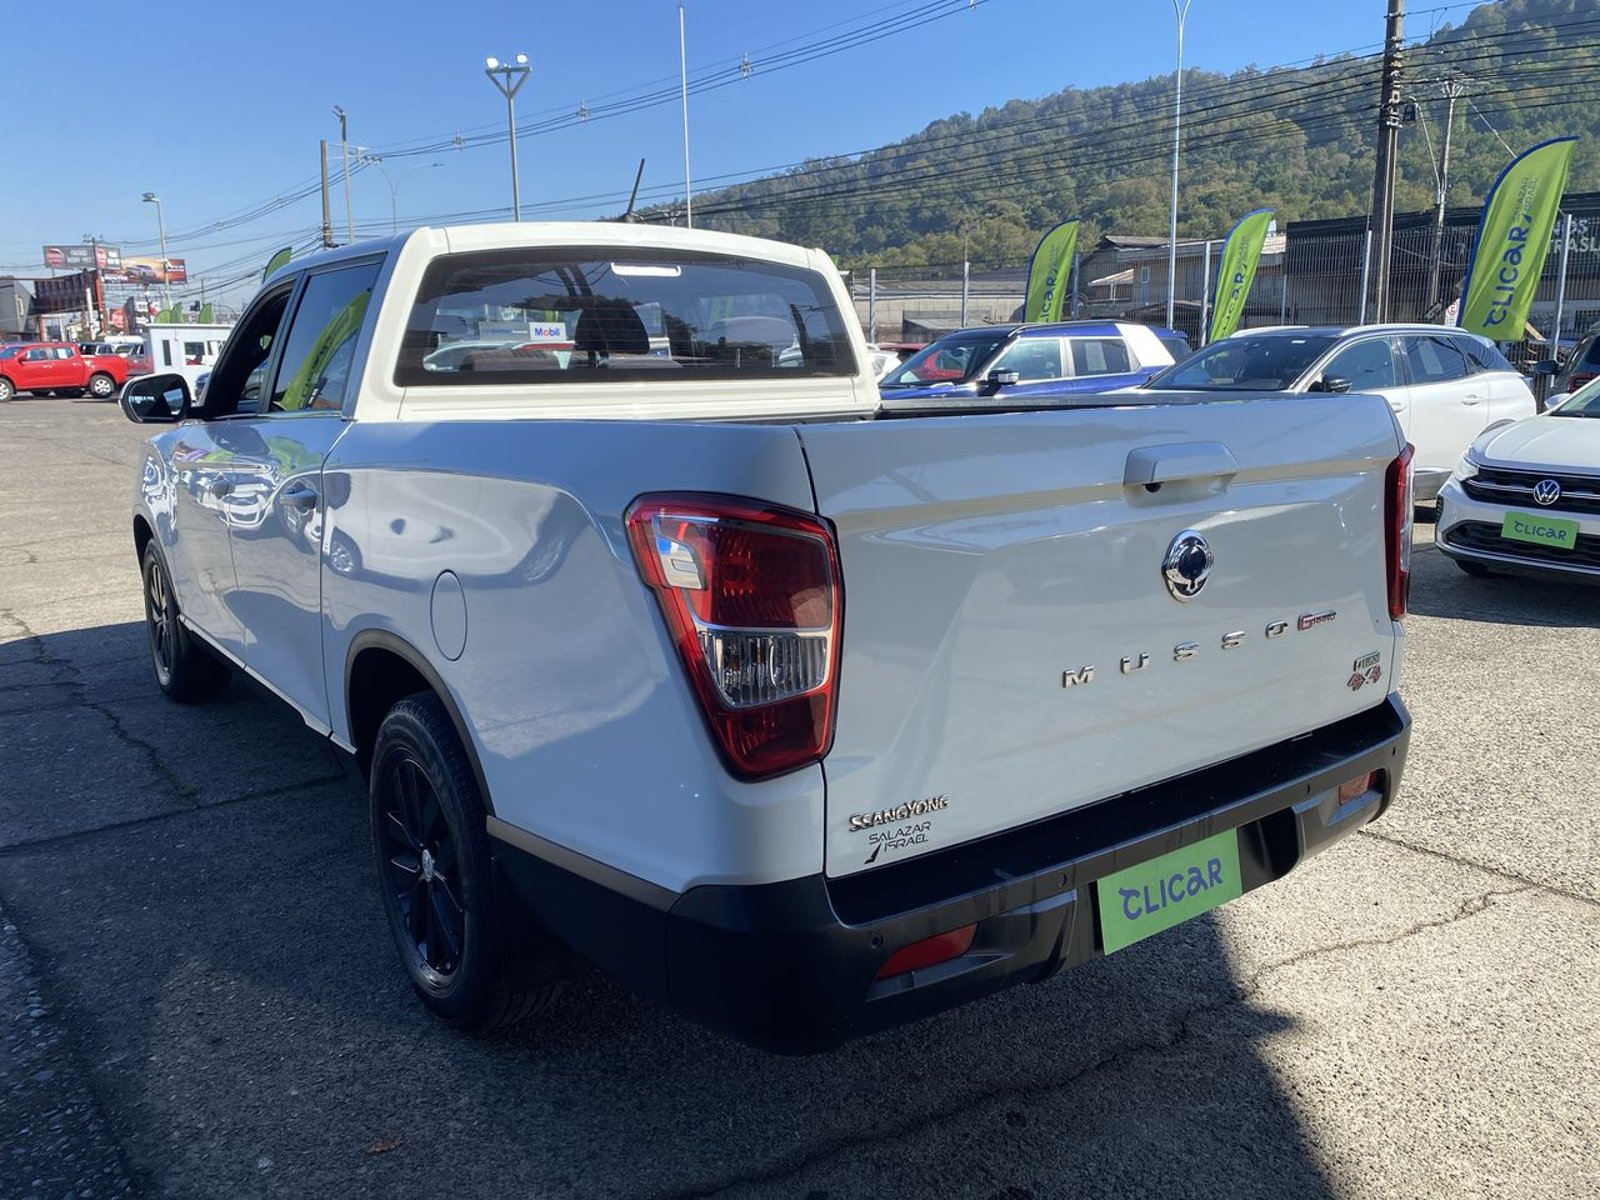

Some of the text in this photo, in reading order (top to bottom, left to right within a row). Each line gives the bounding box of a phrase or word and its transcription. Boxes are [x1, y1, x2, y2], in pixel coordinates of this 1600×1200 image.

[534, 327, 560, 337] Mobil
[1062, 620, 1289, 689] MUSSO
[869, 820, 931, 845] SALAZAR
[883, 834, 930, 852] ISRAEL
